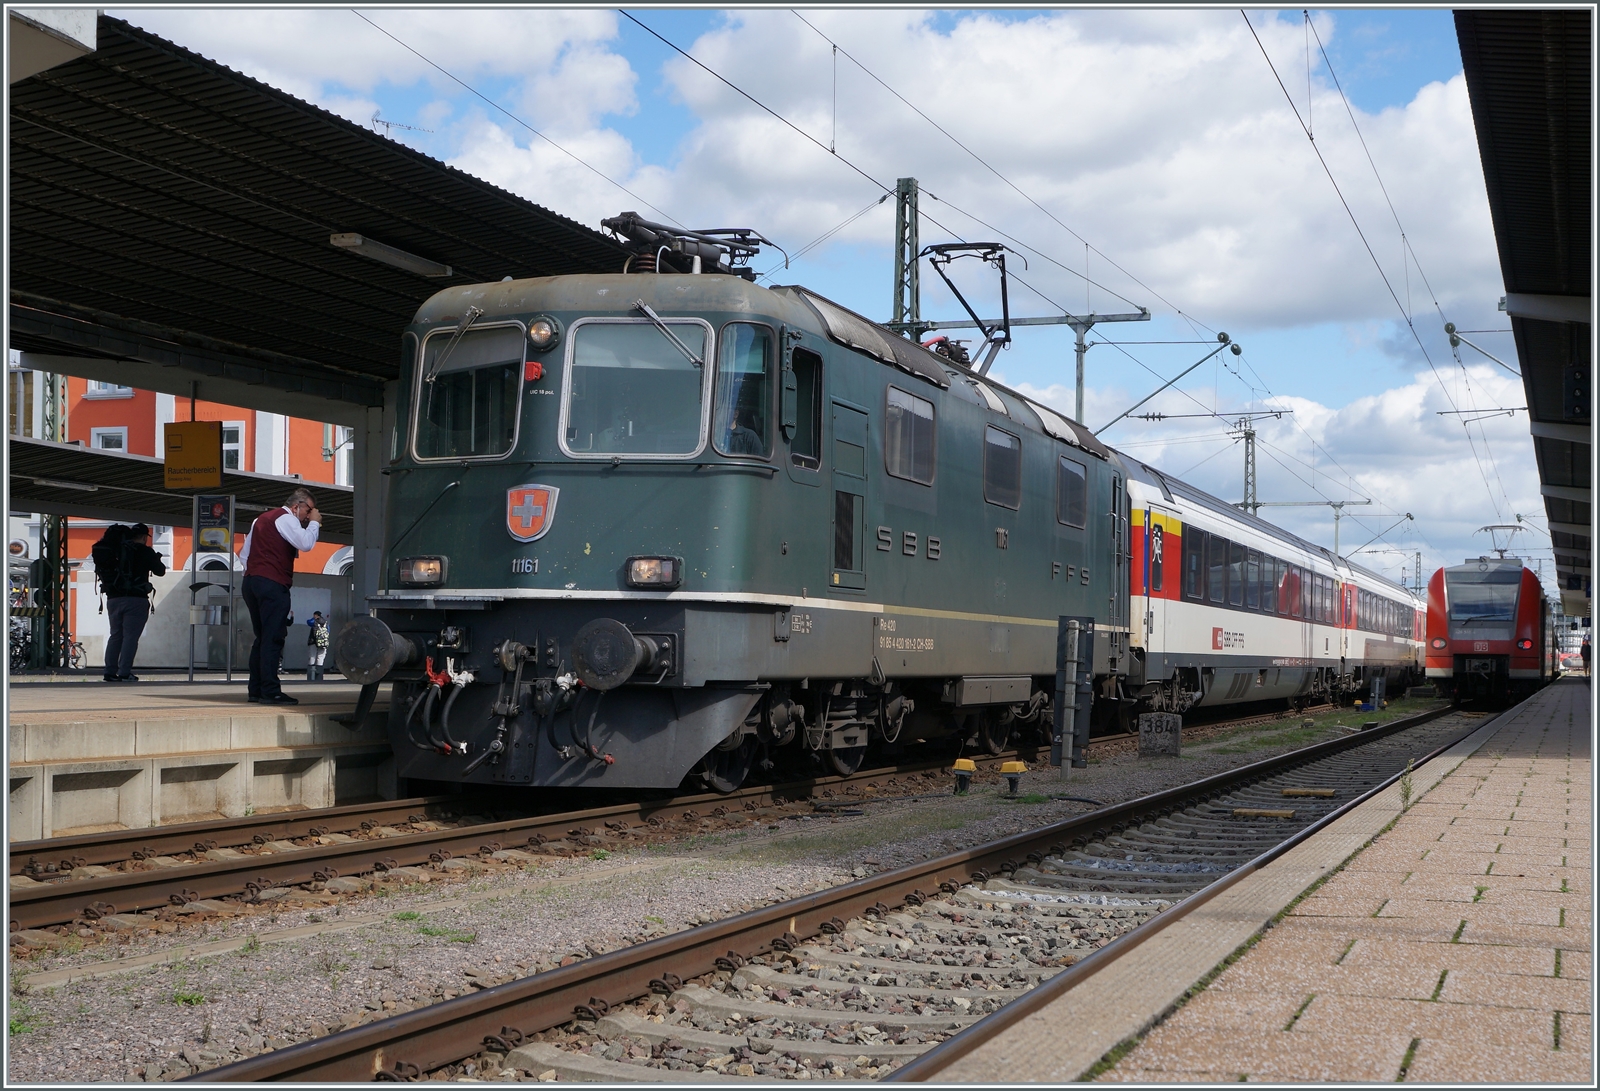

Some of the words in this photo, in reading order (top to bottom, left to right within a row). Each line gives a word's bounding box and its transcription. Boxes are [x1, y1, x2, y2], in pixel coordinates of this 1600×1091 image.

[168, 466, 217, 474] Raucherbereich
[876, 525, 942, 561] SBB
[512, 558, 539, 573] 11161
[1051, 561, 1090, 586] FFS
[880, 618, 887, 631] Re
[887, 619, 897, 632] 420
[896, 637, 905, 650] 420
[1474, 642, 1488, 651] DB
[1143, 719, 1178, 734] 384
